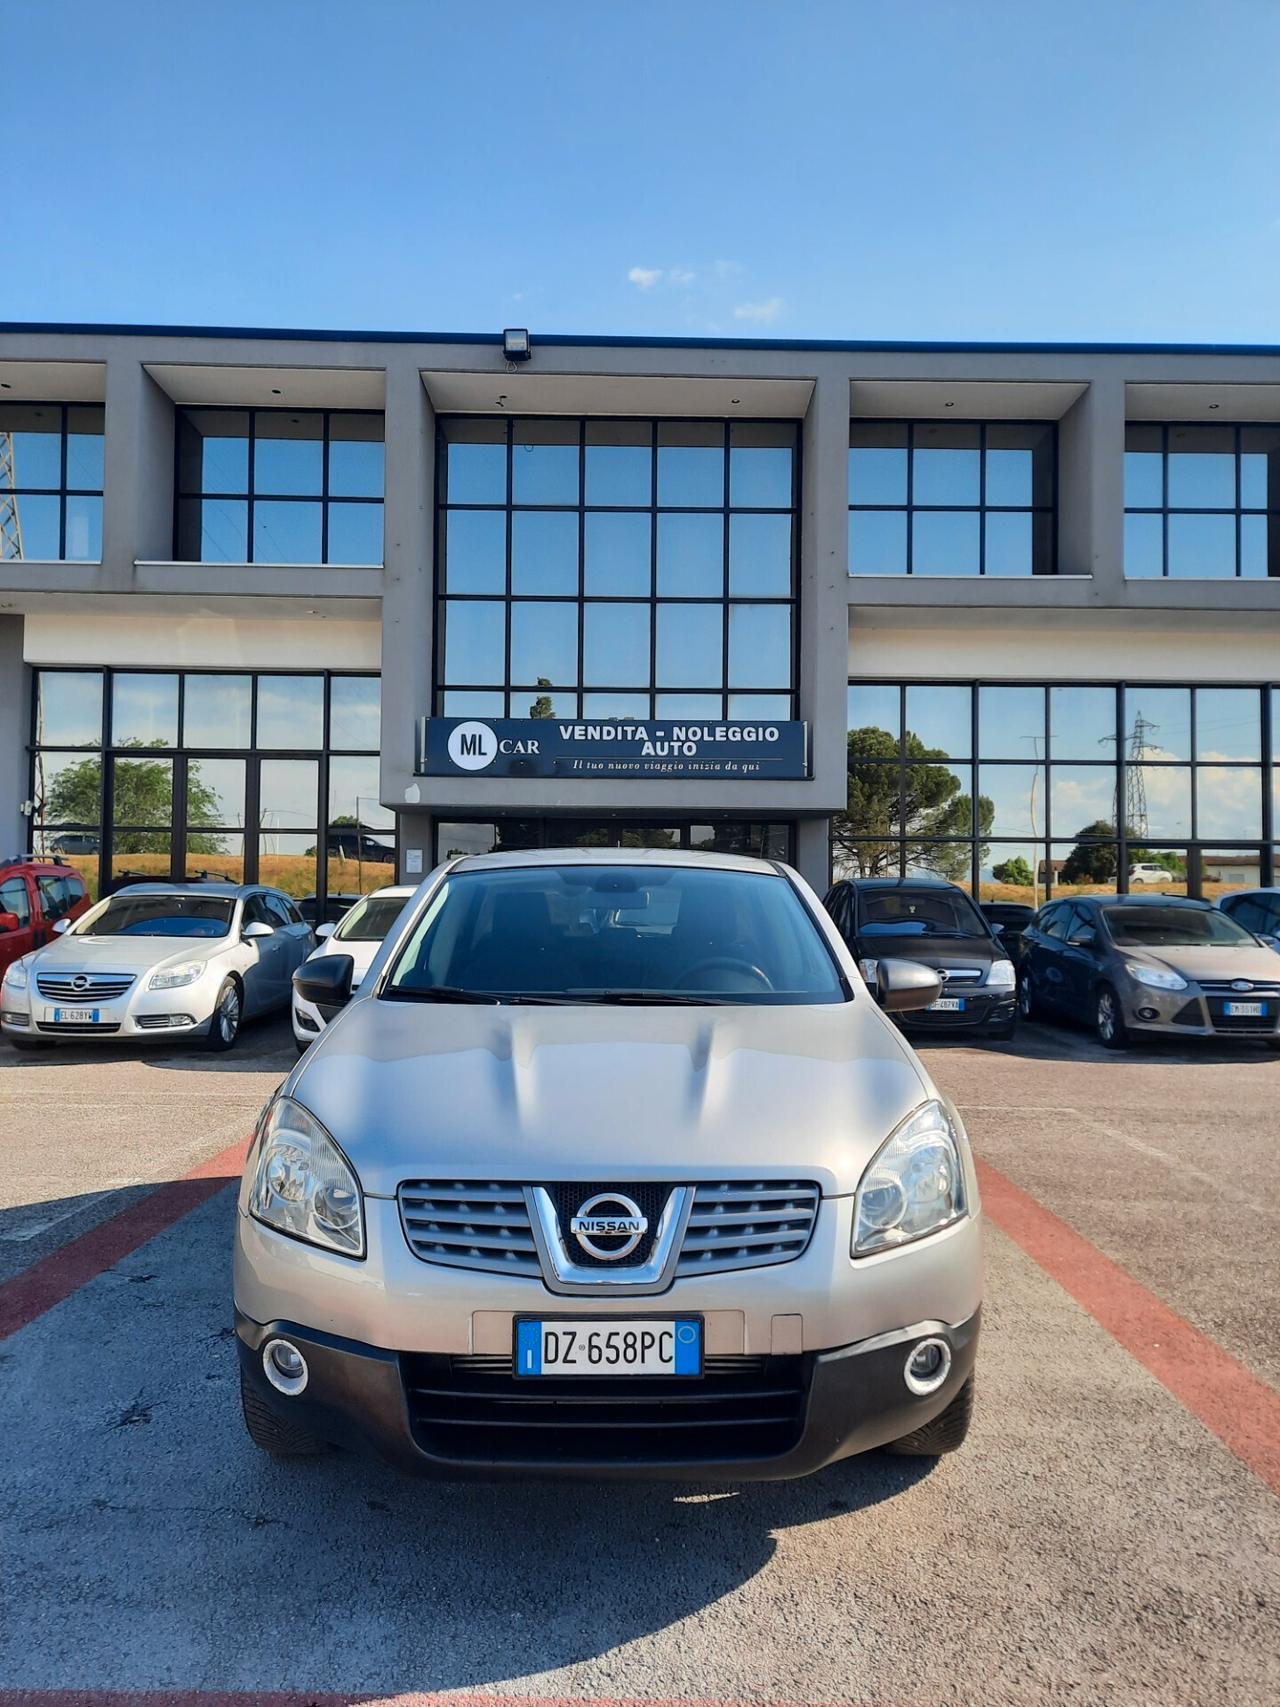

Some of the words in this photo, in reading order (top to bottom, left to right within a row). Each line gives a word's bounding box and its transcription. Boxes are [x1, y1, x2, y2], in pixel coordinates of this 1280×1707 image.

[559, 725, 649, 741] VENDITA
[672, 726, 780, 742] NOLEGGIO
[460, 733, 487, 756] ML
[499, 739, 541, 754] CAR
[641, 740, 697, 756] AUTO
[573, 760, 583, 769] Il
[586, 761, 604, 770] tuo
[608, 762, 640, 770] nuovo
[644, 760, 684, 773] viaggio
[688, 761, 721, 771] inizia
[725, 760, 738, 771] da
[742, 761, 760, 774] qui
[578, 1221, 640, 1231] NISSAN
